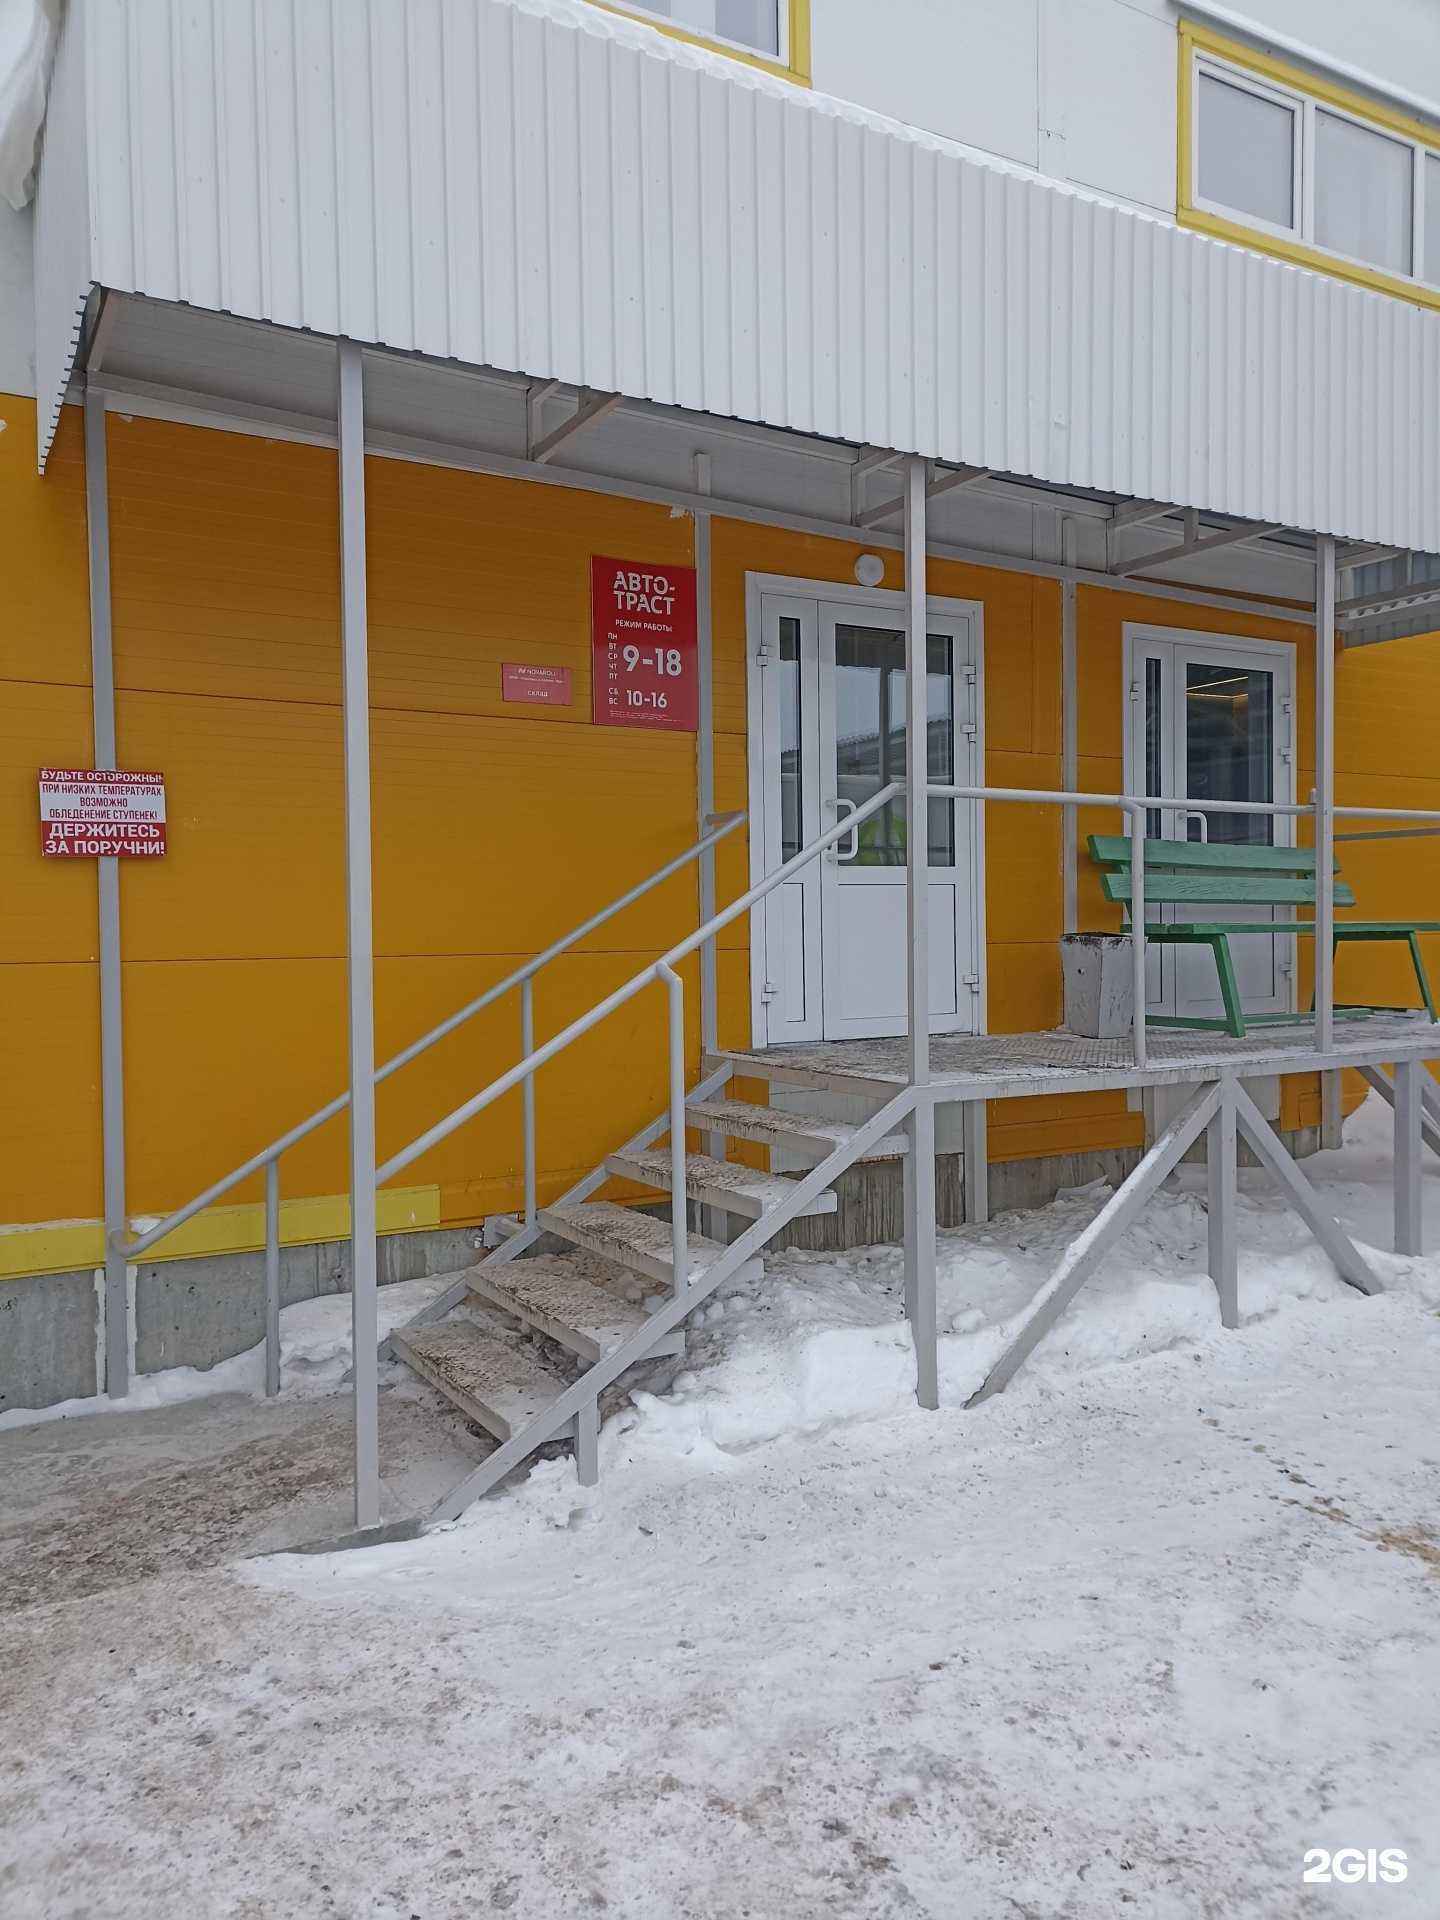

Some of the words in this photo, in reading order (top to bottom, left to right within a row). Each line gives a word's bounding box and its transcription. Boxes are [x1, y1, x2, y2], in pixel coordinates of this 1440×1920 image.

[613, 571, 676, 595] АВТО-
[613, 590, 676, 615] ТРАСТ
[615, 619, 642, 629] РЕЖИМ
[643, 622, 673, 632] РАБОТЫ
[622, 644, 682, 677] 9-18
[609, 672, 618, 680] ПТ
[608, 687, 619, 696] СБ
[608, 697, 619, 705] ВС
[626, 689, 668, 709] 10-16
[41, 770, 85, 782] БУДЬТЕ
[42, 783, 60, 793] ПРИ
[62, 784, 96, 795] НИЗКИХ
[98, 785, 162, 796] ТЕМПЕРАТУРАХ
[80, 797, 128, 808] ВОЗМОЖНО
[49, 808, 111, 819] ОБЛЕДЕНЕНИЕ
[113, 809, 158, 820] СТУПЕНЕК!
[49, 823, 160, 839] ДЕРЖИТЕСЬ
[45, 841, 70, 854] ЗА
[74, 841, 165, 855] ПОРУЧНИ!
